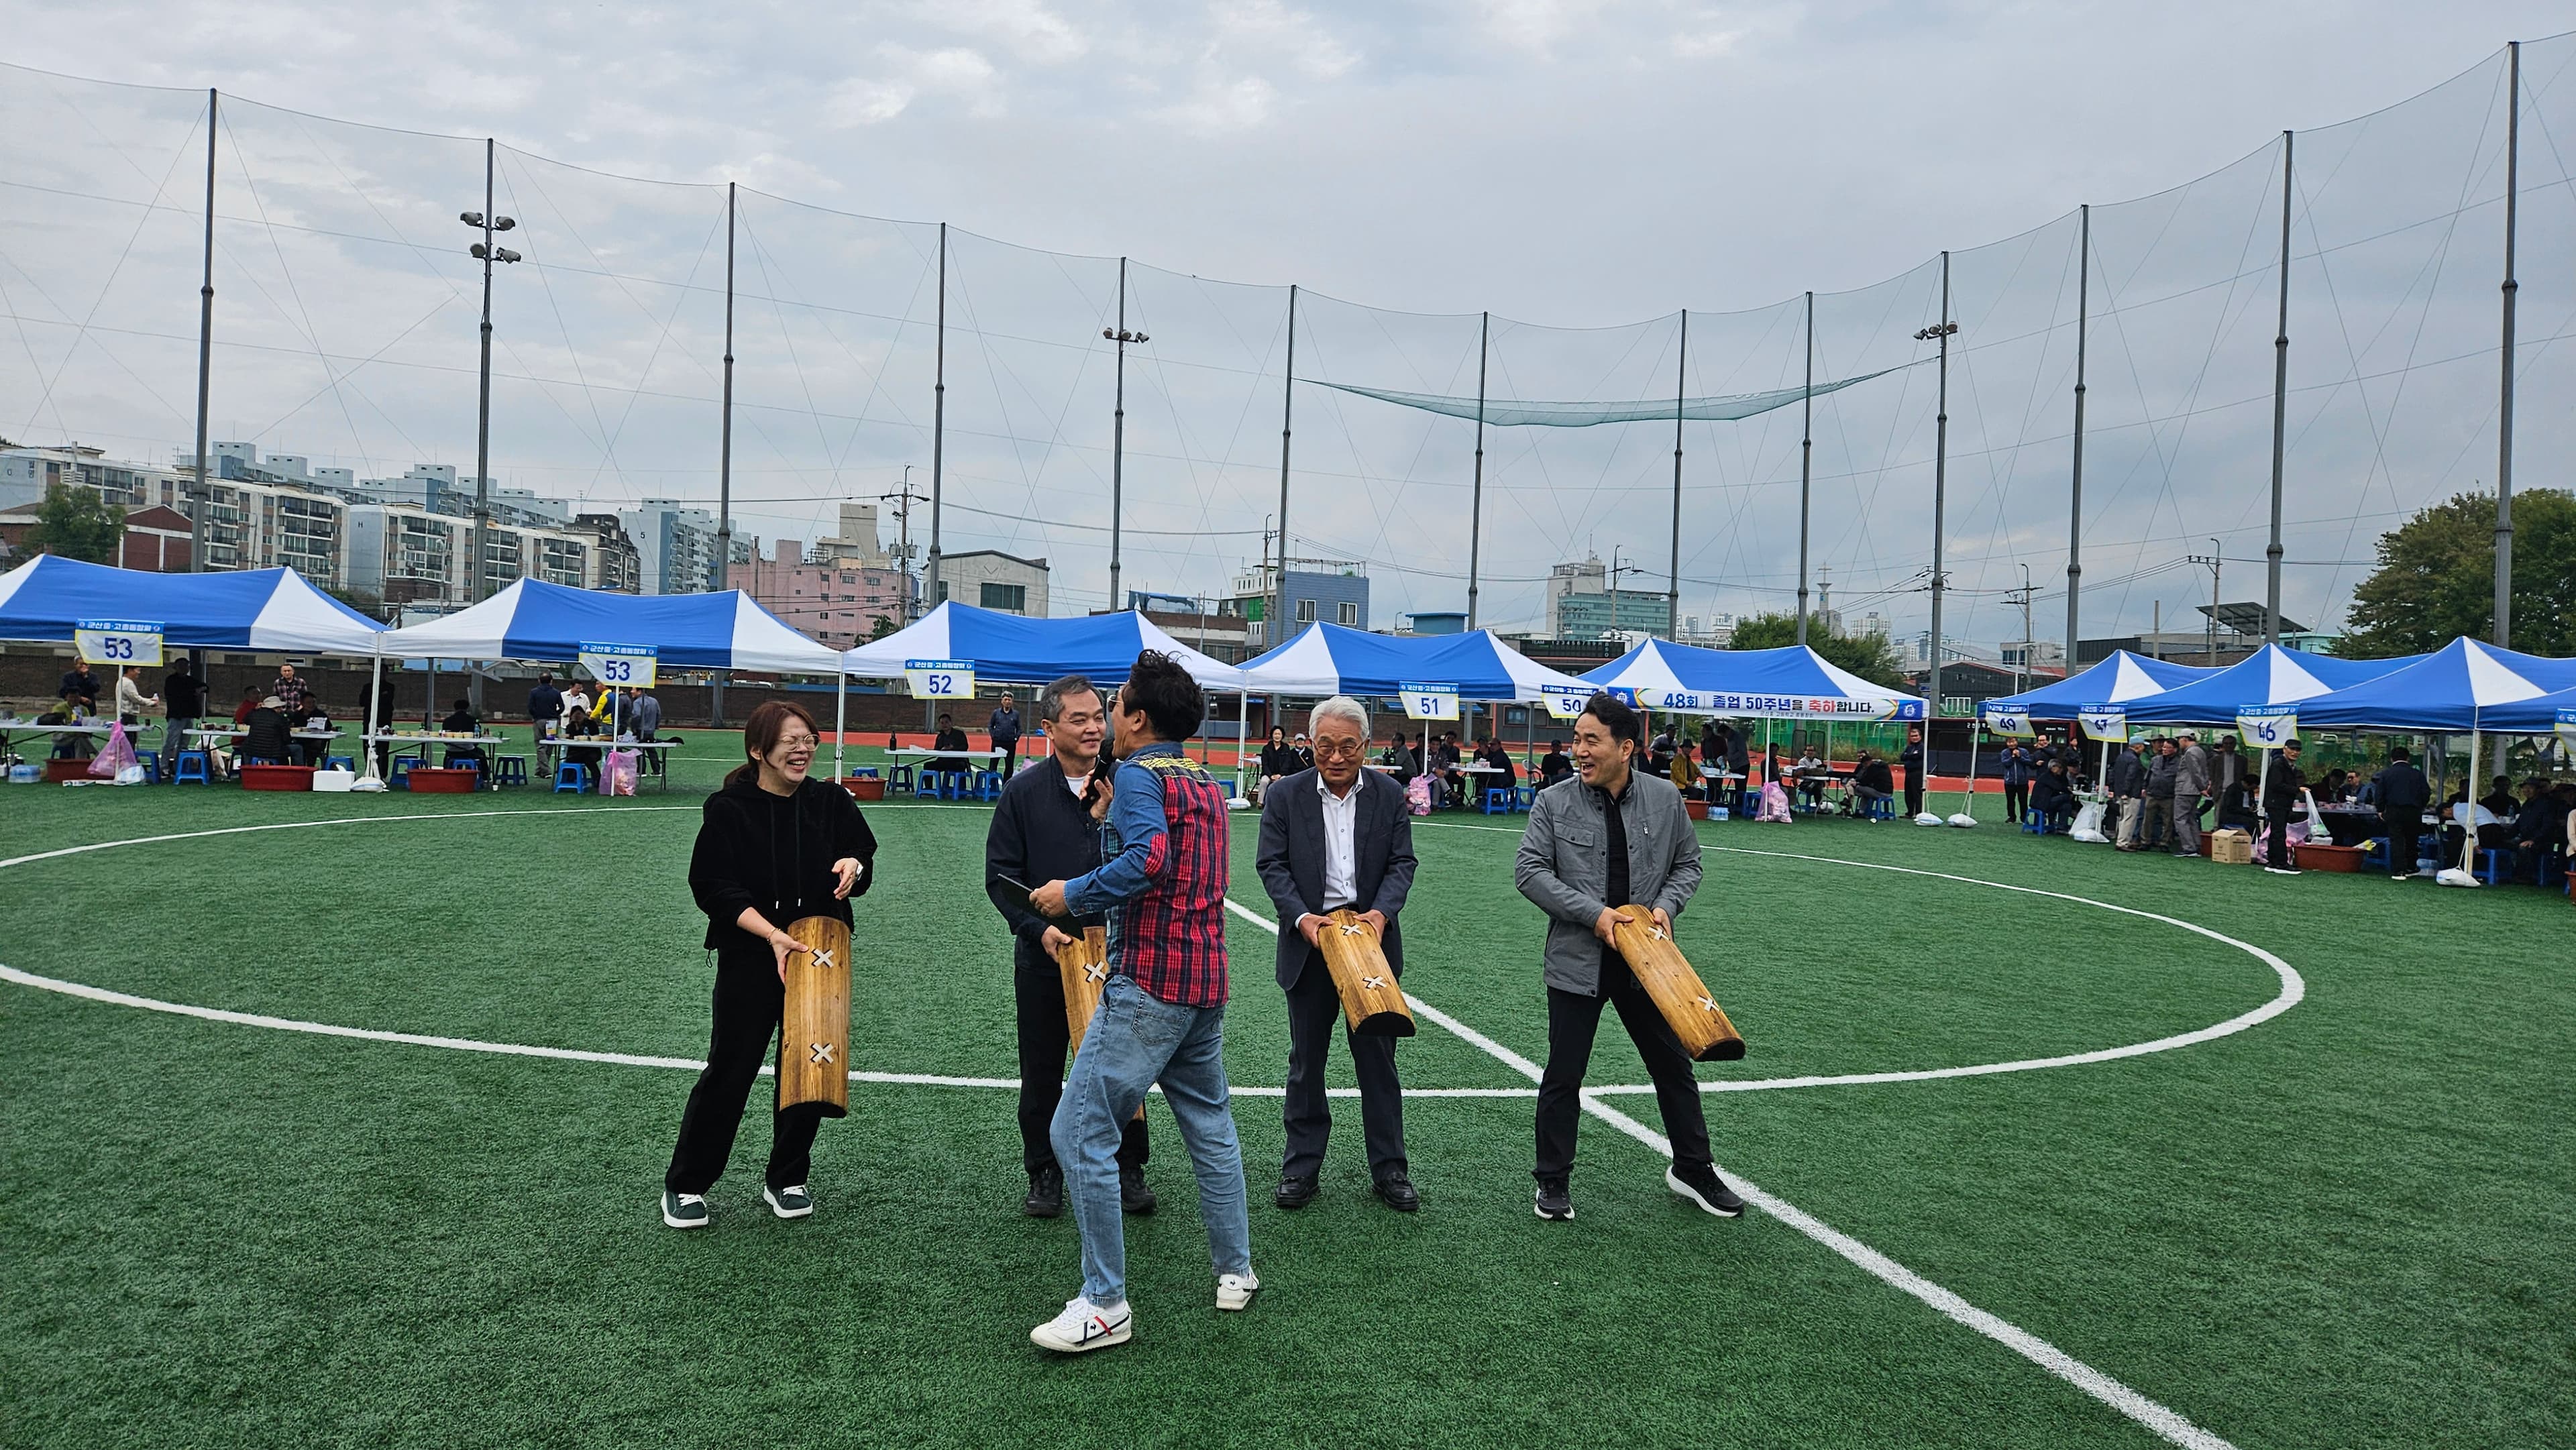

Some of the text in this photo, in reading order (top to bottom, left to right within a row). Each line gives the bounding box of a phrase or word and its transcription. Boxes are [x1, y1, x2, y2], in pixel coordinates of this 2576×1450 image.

[104, 637, 133, 659] 53
[605, 661, 631, 681] 53
[929, 675, 951, 693] 52
[1421, 698, 1438, 715] 51
[1562, 699, 1582, 712] 50
[1664, 693, 1874, 713] 48회 졸업 50주년을 축하합니다.
[2000, 718, 2017, 732] 49
[2258, 722, 2276, 742] 46
